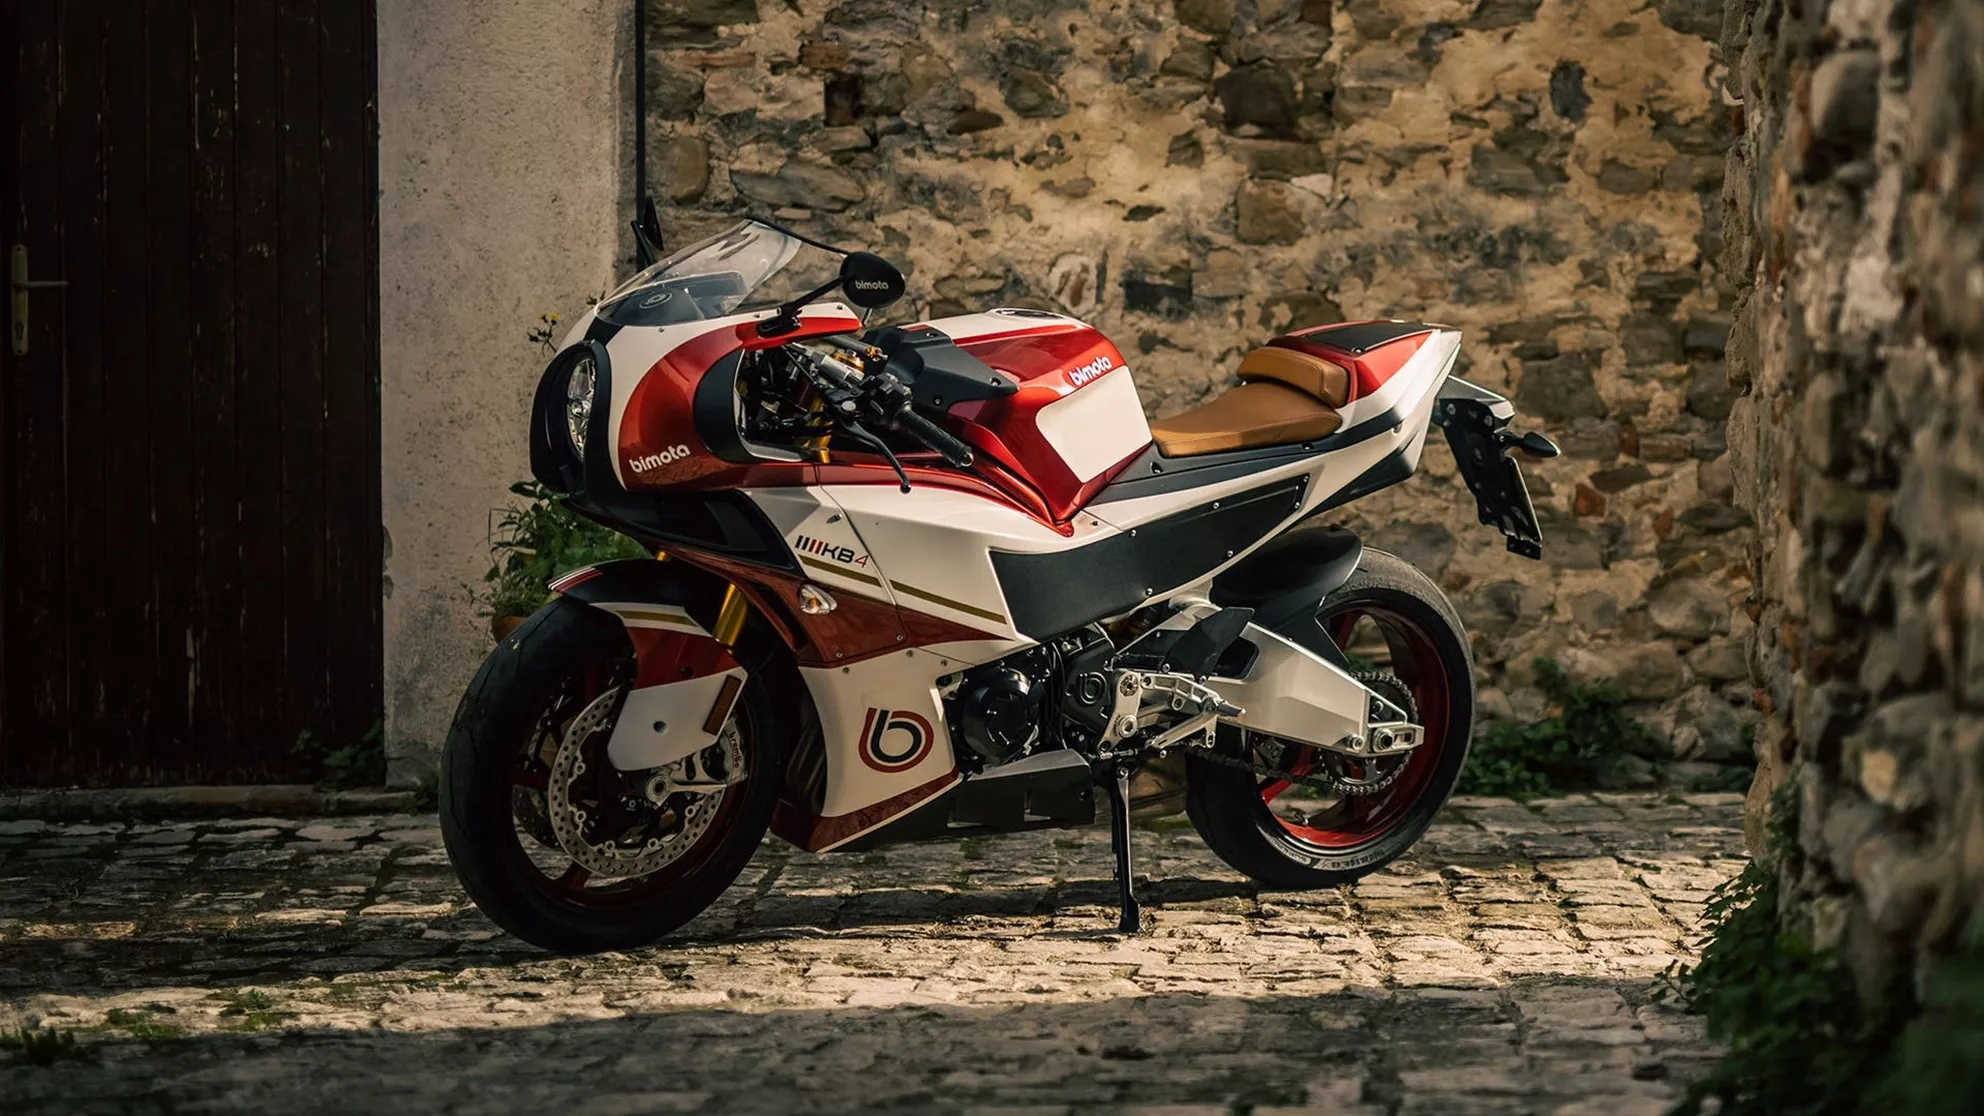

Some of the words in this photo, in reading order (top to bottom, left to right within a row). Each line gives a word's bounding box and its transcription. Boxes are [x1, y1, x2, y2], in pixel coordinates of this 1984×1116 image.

[854, 280, 889, 290] bimota
[1067, 356, 1113, 386] bimota
[628, 444, 691, 473] bimota
[820, 543, 869, 568] KB4
